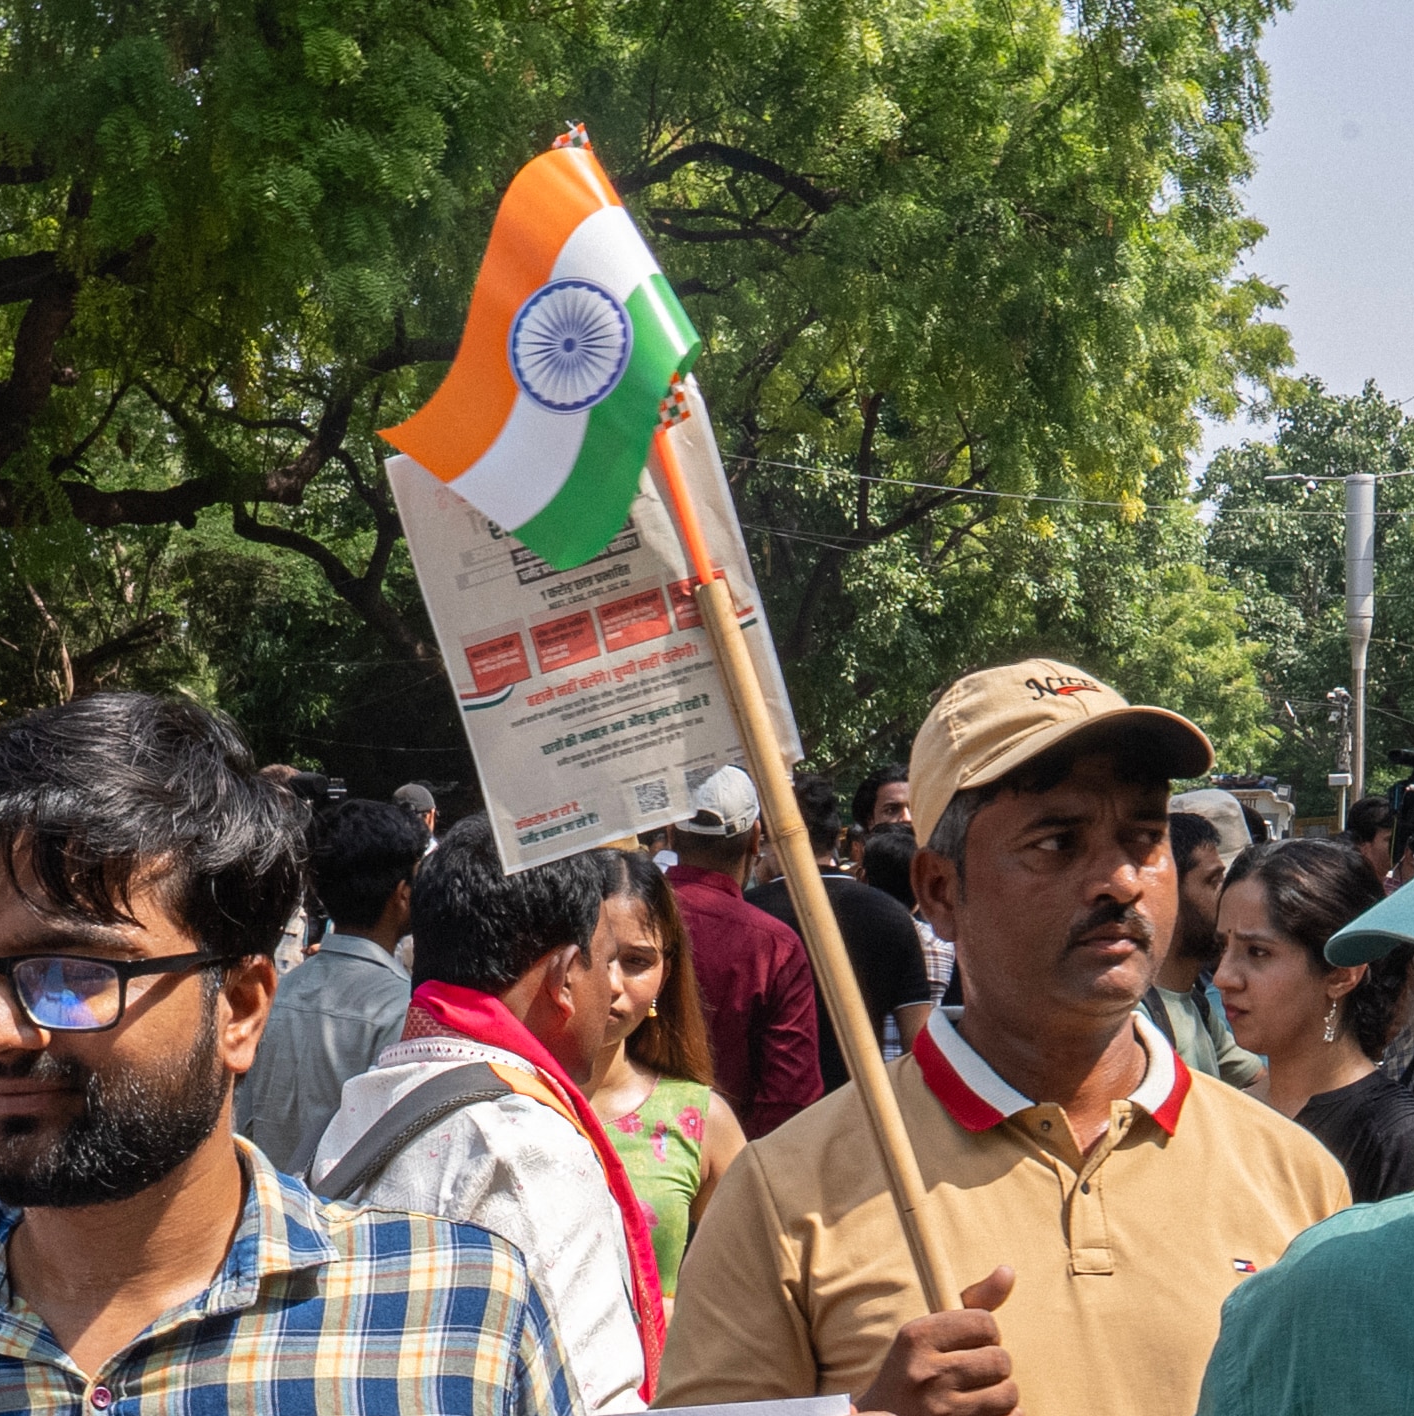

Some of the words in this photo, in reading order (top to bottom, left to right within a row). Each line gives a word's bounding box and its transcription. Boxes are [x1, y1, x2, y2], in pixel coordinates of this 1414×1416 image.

[525, 686, 554, 706] बहाने
[554, 678, 577, 696] नहीं
[637, 652, 660, 670] नहीं
[628, 713, 646, 727] और
